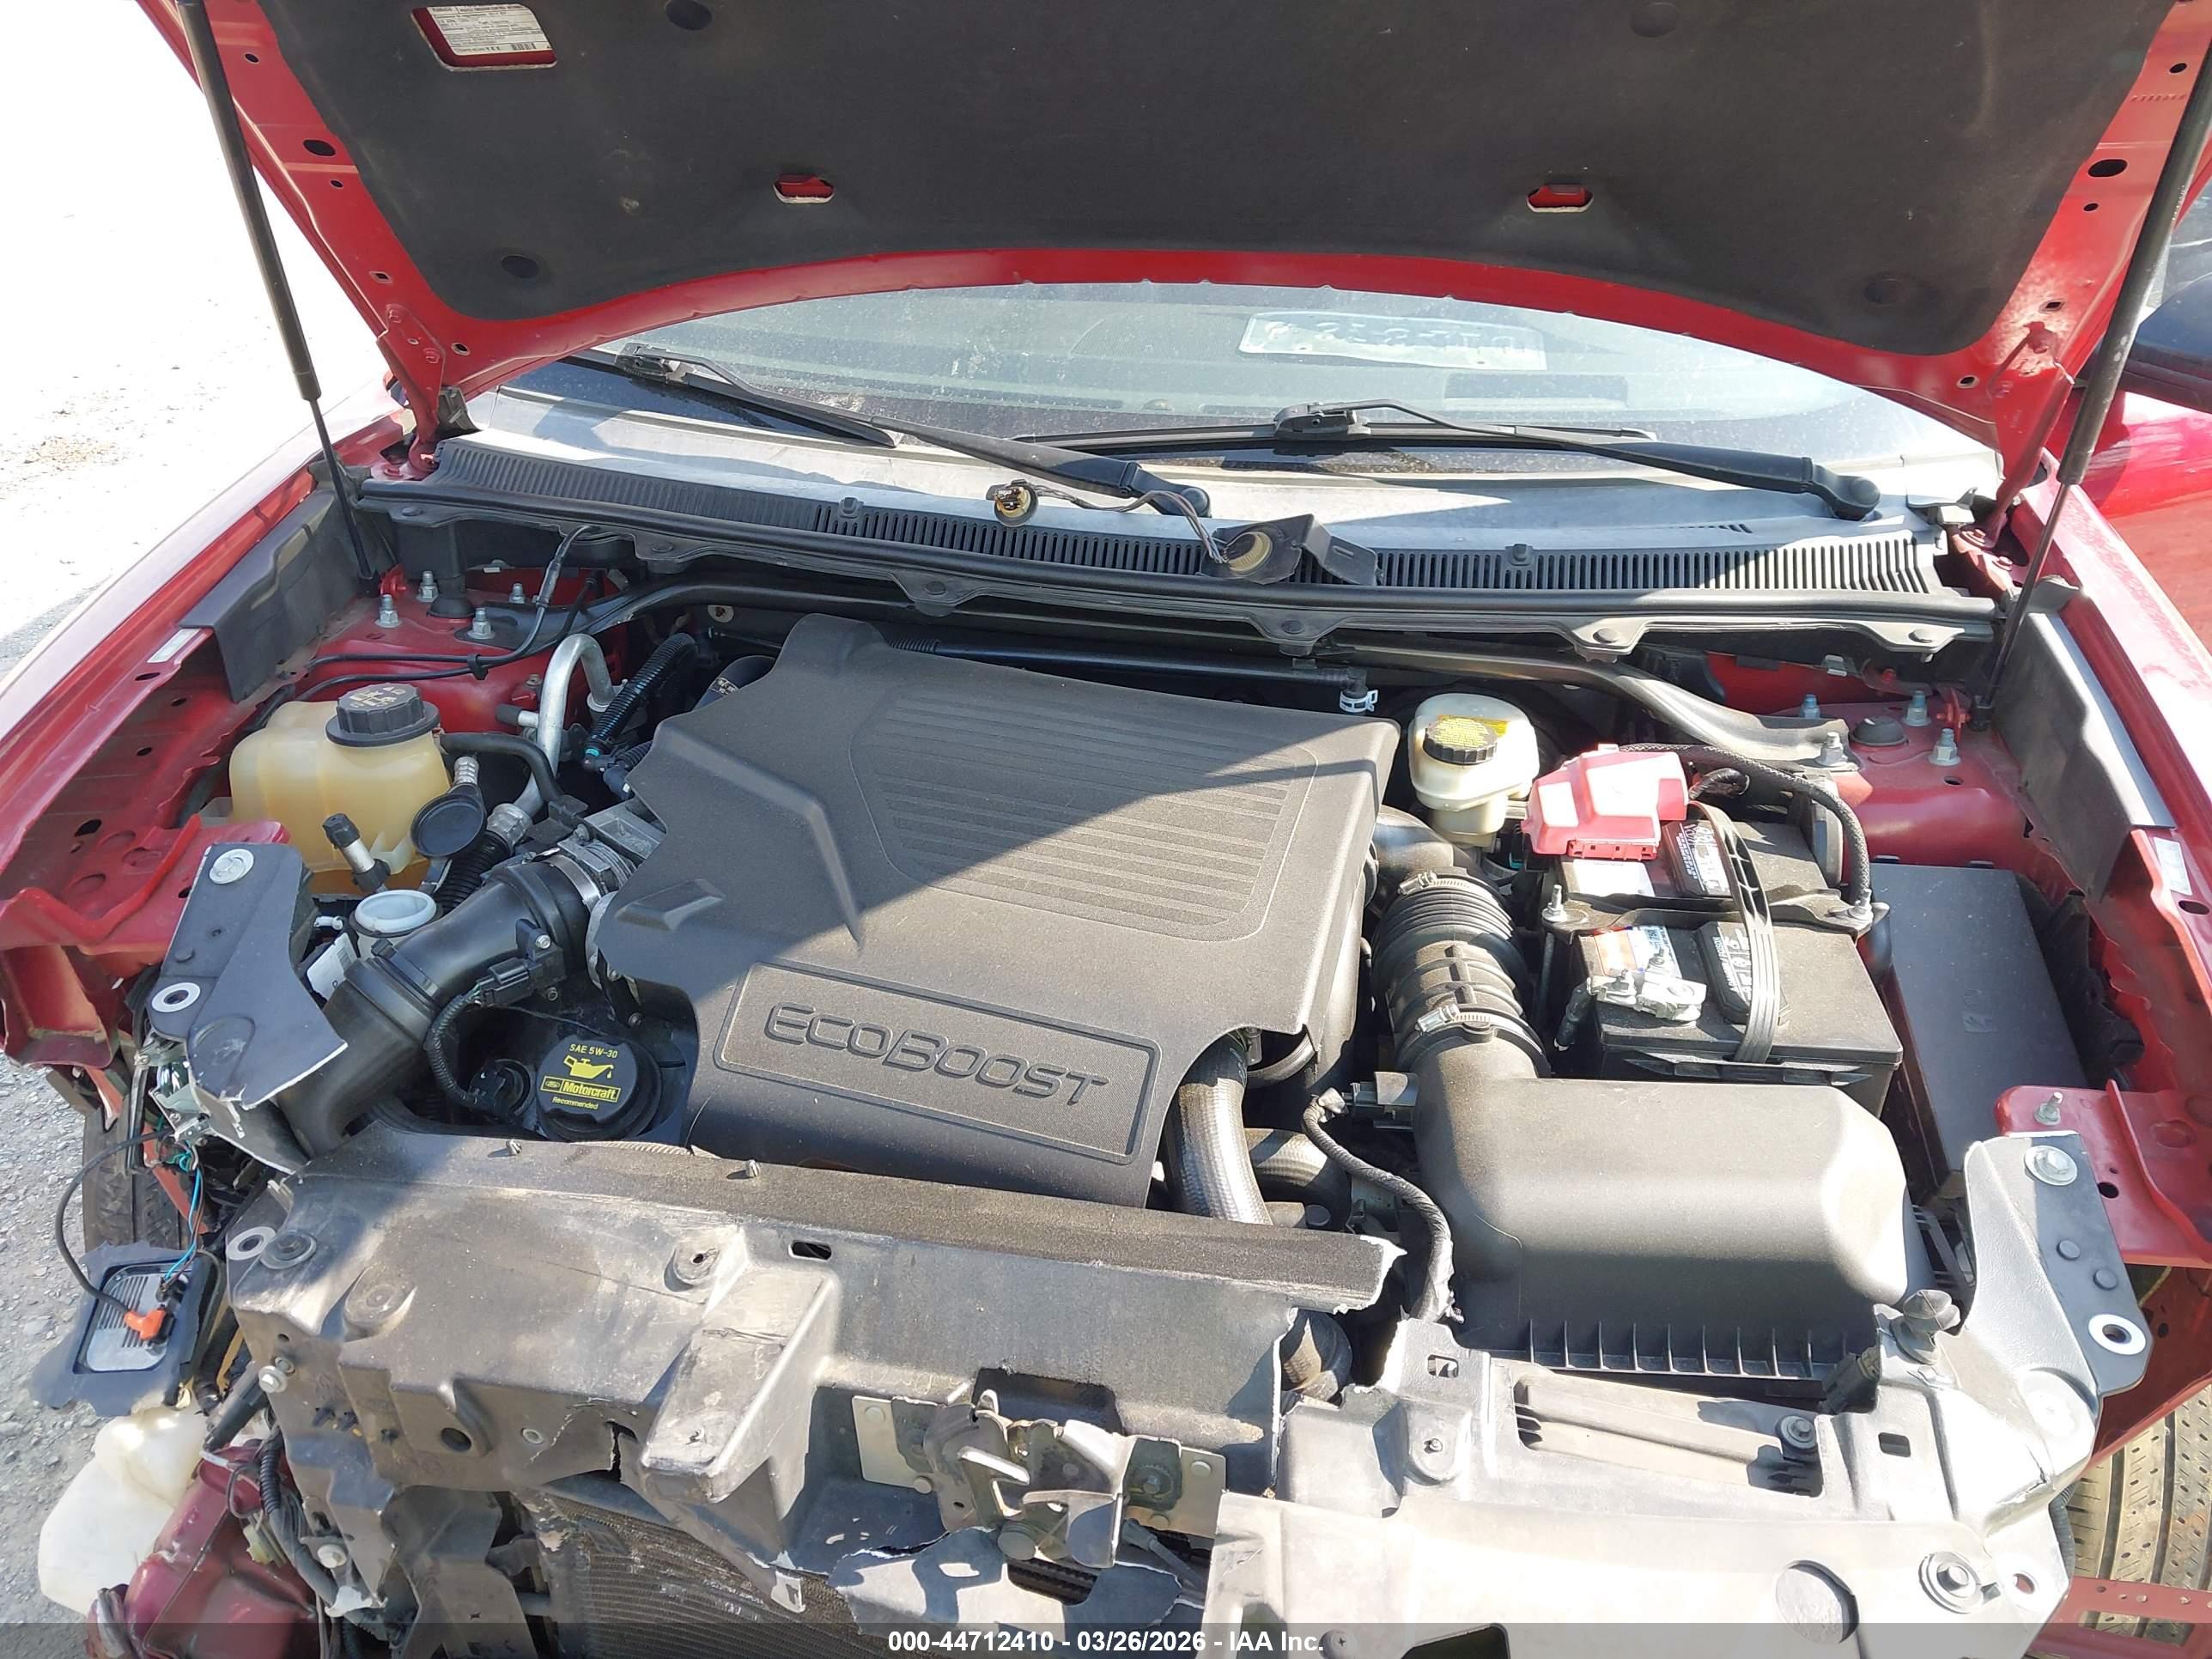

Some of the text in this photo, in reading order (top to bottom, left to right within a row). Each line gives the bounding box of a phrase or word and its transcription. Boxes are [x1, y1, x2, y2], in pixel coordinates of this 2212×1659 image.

[569, 1044, 617, 1058] SAE 5W-30
[563, 1082, 617, 1100] Motorcraft
[552, 1097, 599, 1109] Recommended
